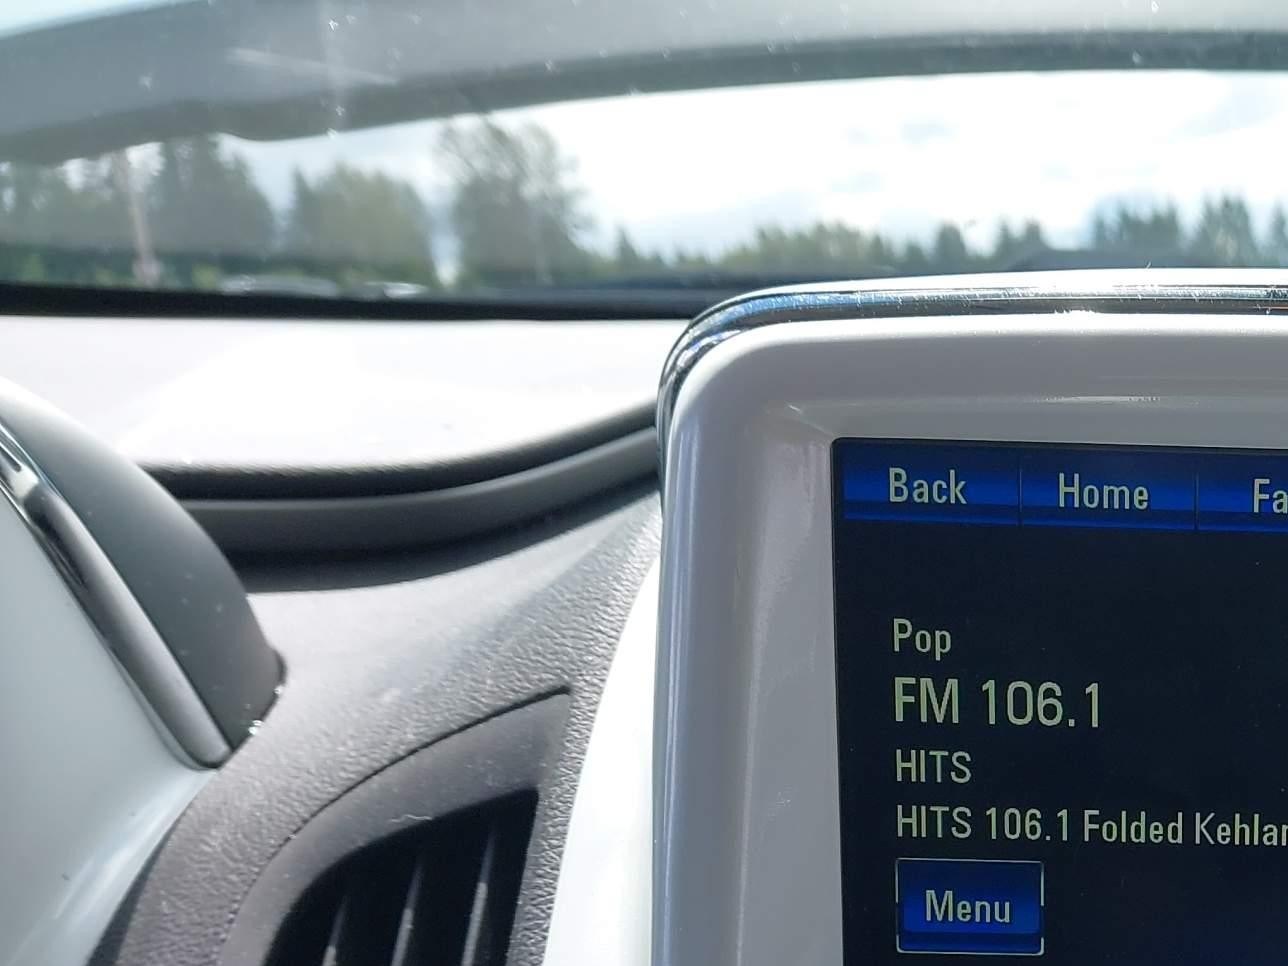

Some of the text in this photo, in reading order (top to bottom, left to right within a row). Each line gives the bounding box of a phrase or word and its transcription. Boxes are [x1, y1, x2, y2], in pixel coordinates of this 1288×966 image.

[888, 468, 967, 504] Back
[1059, 473, 1148, 509] Home
[893, 619, 951, 660] Pop
[894, 677, 1101, 728] FM 106.1
[896, 750, 971, 783] HITS
[896, 805, 971, 838] HITS
[986, 808, 1068, 841] 106.1
[1084, 810, 1183, 844] Folded
[925, 890, 1011, 923] Menu
